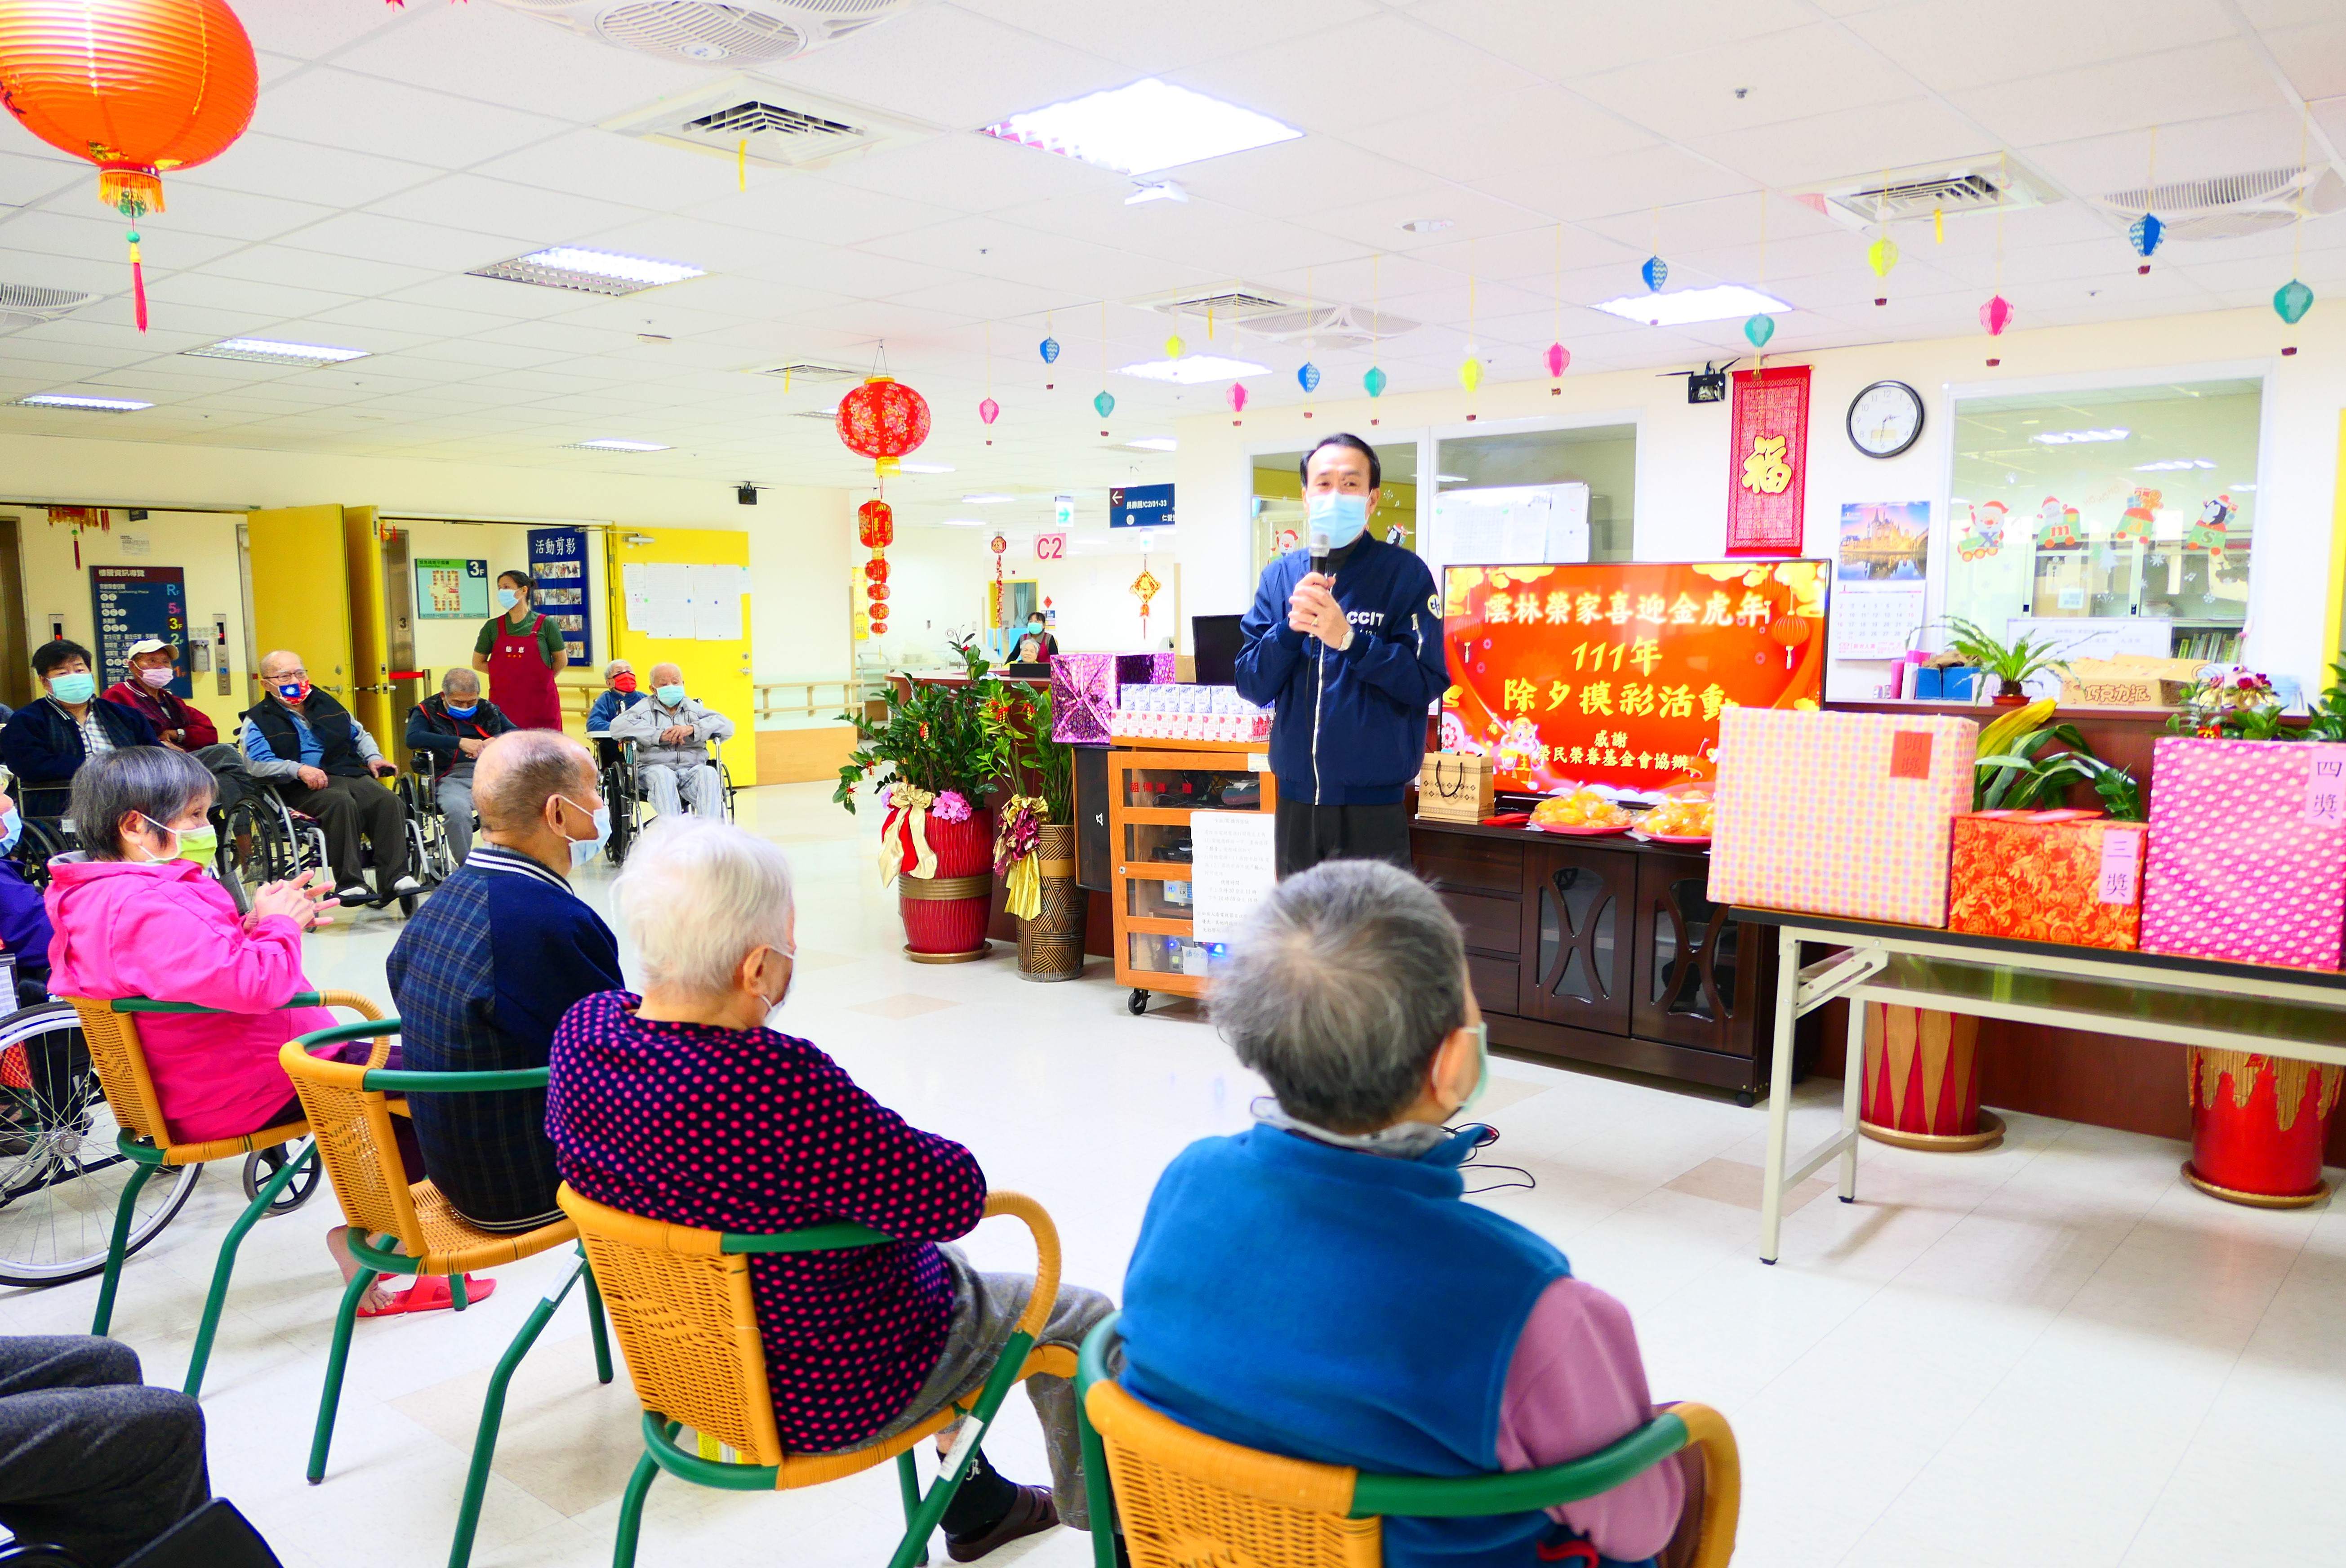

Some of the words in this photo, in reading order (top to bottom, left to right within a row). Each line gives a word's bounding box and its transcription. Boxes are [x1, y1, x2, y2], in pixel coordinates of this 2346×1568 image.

[1741, 435, 1792, 494] 福
[535, 537, 575, 555] 活動剪影
[1037, 538, 1062, 559] C2
[470, 561, 484, 576] 3F
[1346, 611, 1384, 626] CCIT
[1485, 591, 1767, 627] 雲林榮家喜迎金虎年
[169, 618, 182, 629] 3F
[400, 618, 406, 628] 3
[1572, 635, 1662, 677] 111年
[1504, 677, 1740, 722] 除夕摸彩活動
[2084, 684, 2151, 702] 巧克力派
[1594, 730, 1628, 748] 感謝
[1539, 744, 1689, 772] 榮民榮眷基金會協辦
[2312, 761, 2342, 820] 四獎
[2106, 841, 2132, 897] 三獎
